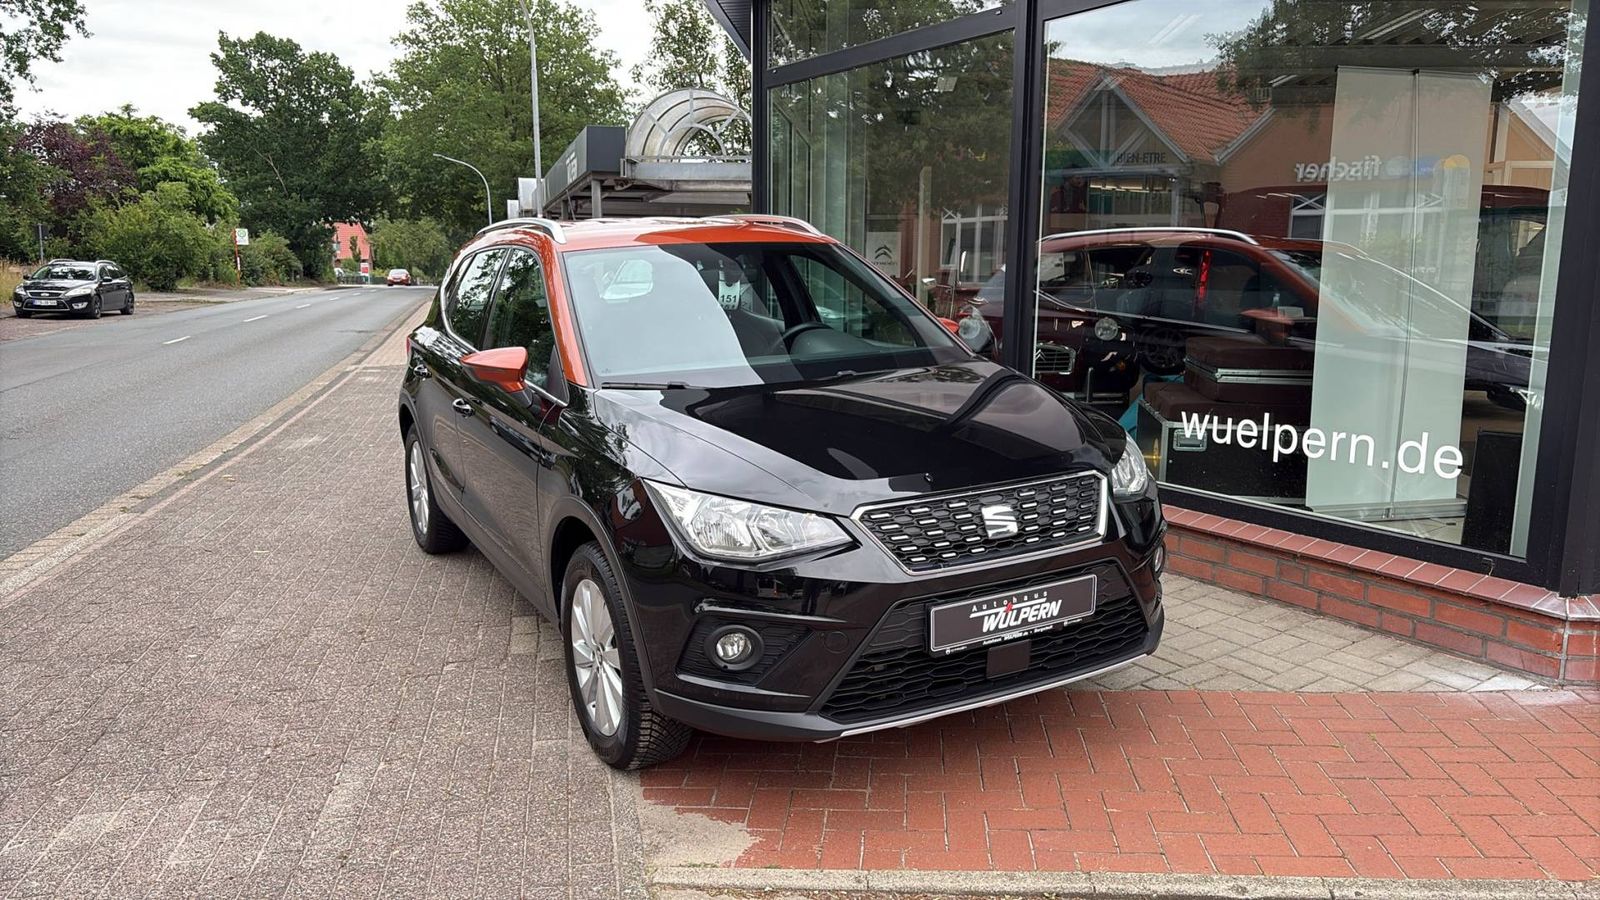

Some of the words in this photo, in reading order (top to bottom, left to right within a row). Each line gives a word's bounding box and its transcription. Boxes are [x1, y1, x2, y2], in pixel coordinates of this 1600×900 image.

[720, 294, 737, 303] 151
[1181, 411, 1464, 480] wuelpern.de
[972, 591, 1048, 612] Autohaus
